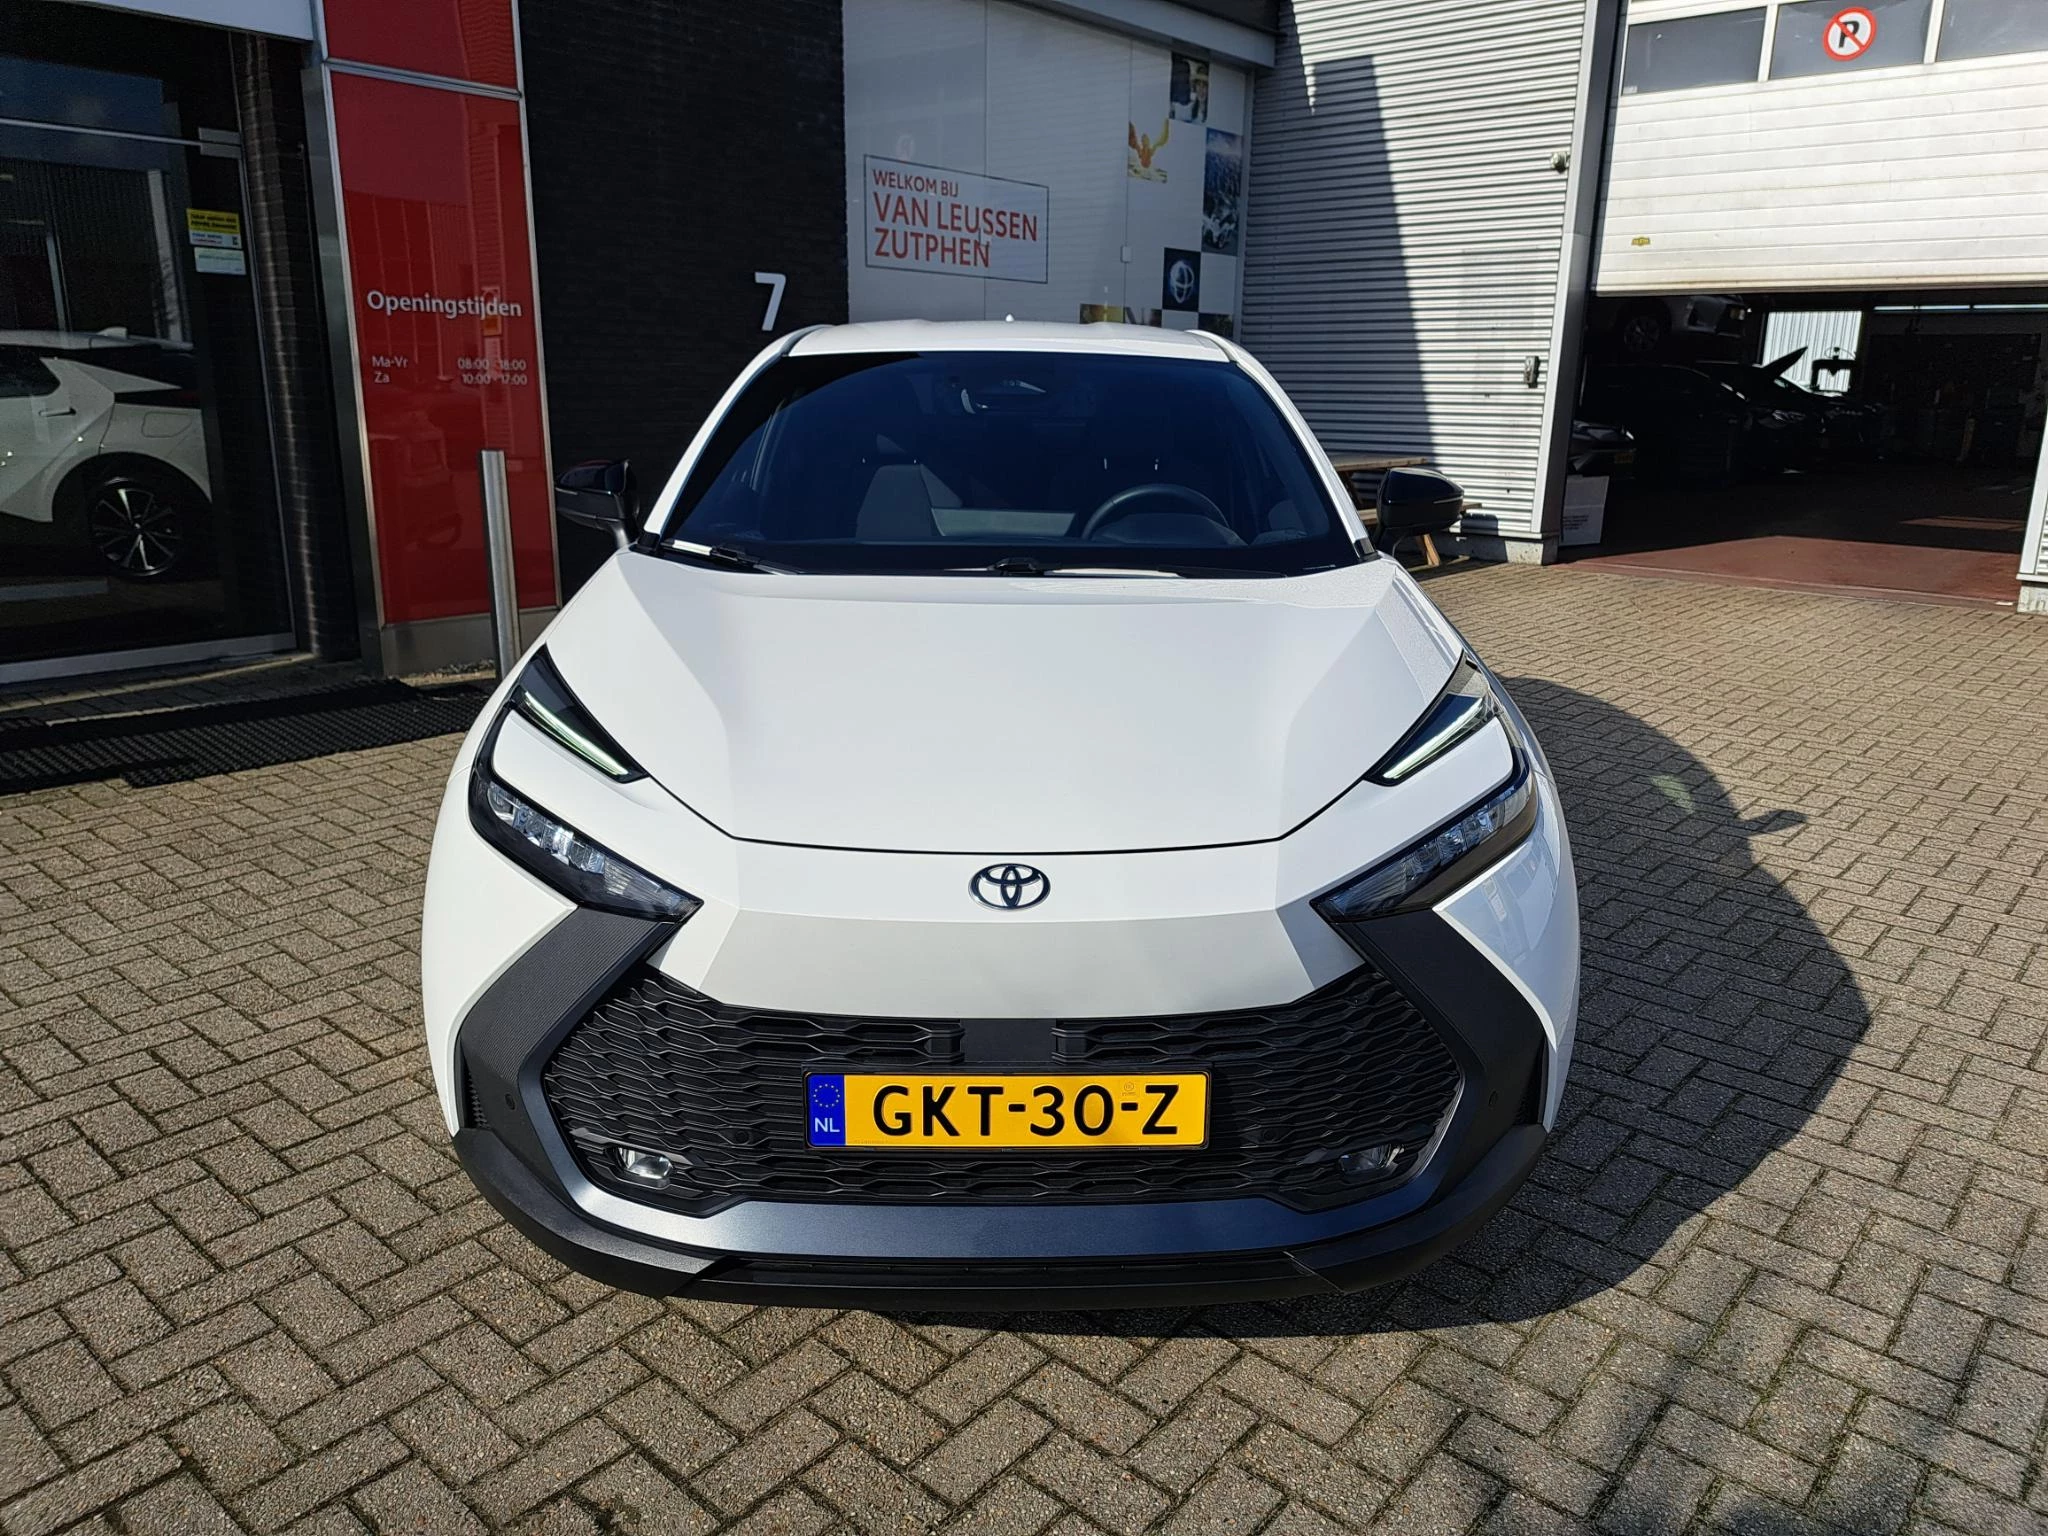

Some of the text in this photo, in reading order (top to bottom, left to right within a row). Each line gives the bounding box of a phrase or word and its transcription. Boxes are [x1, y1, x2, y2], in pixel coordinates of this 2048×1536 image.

[1838, 20, 1860, 48] P
[872, 168, 959, 198] WELKOM BIJ
[872, 191, 1038, 242] VAN LEUSSEN
[874, 227, 991, 268] ZUTPHEN
[366, 290, 523, 320] Openingstijden
[754, 271, 787, 331] 7
[371, 355, 409, 369] Ma-Vr
[457, 357, 490, 371] 08:00
[373, 371, 390, 384] Za
[461, 372, 491, 385] 10:00
[814, 1117, 840, 1133] NL
[872, 1084, 1180, 1137] GKT-30-Z
